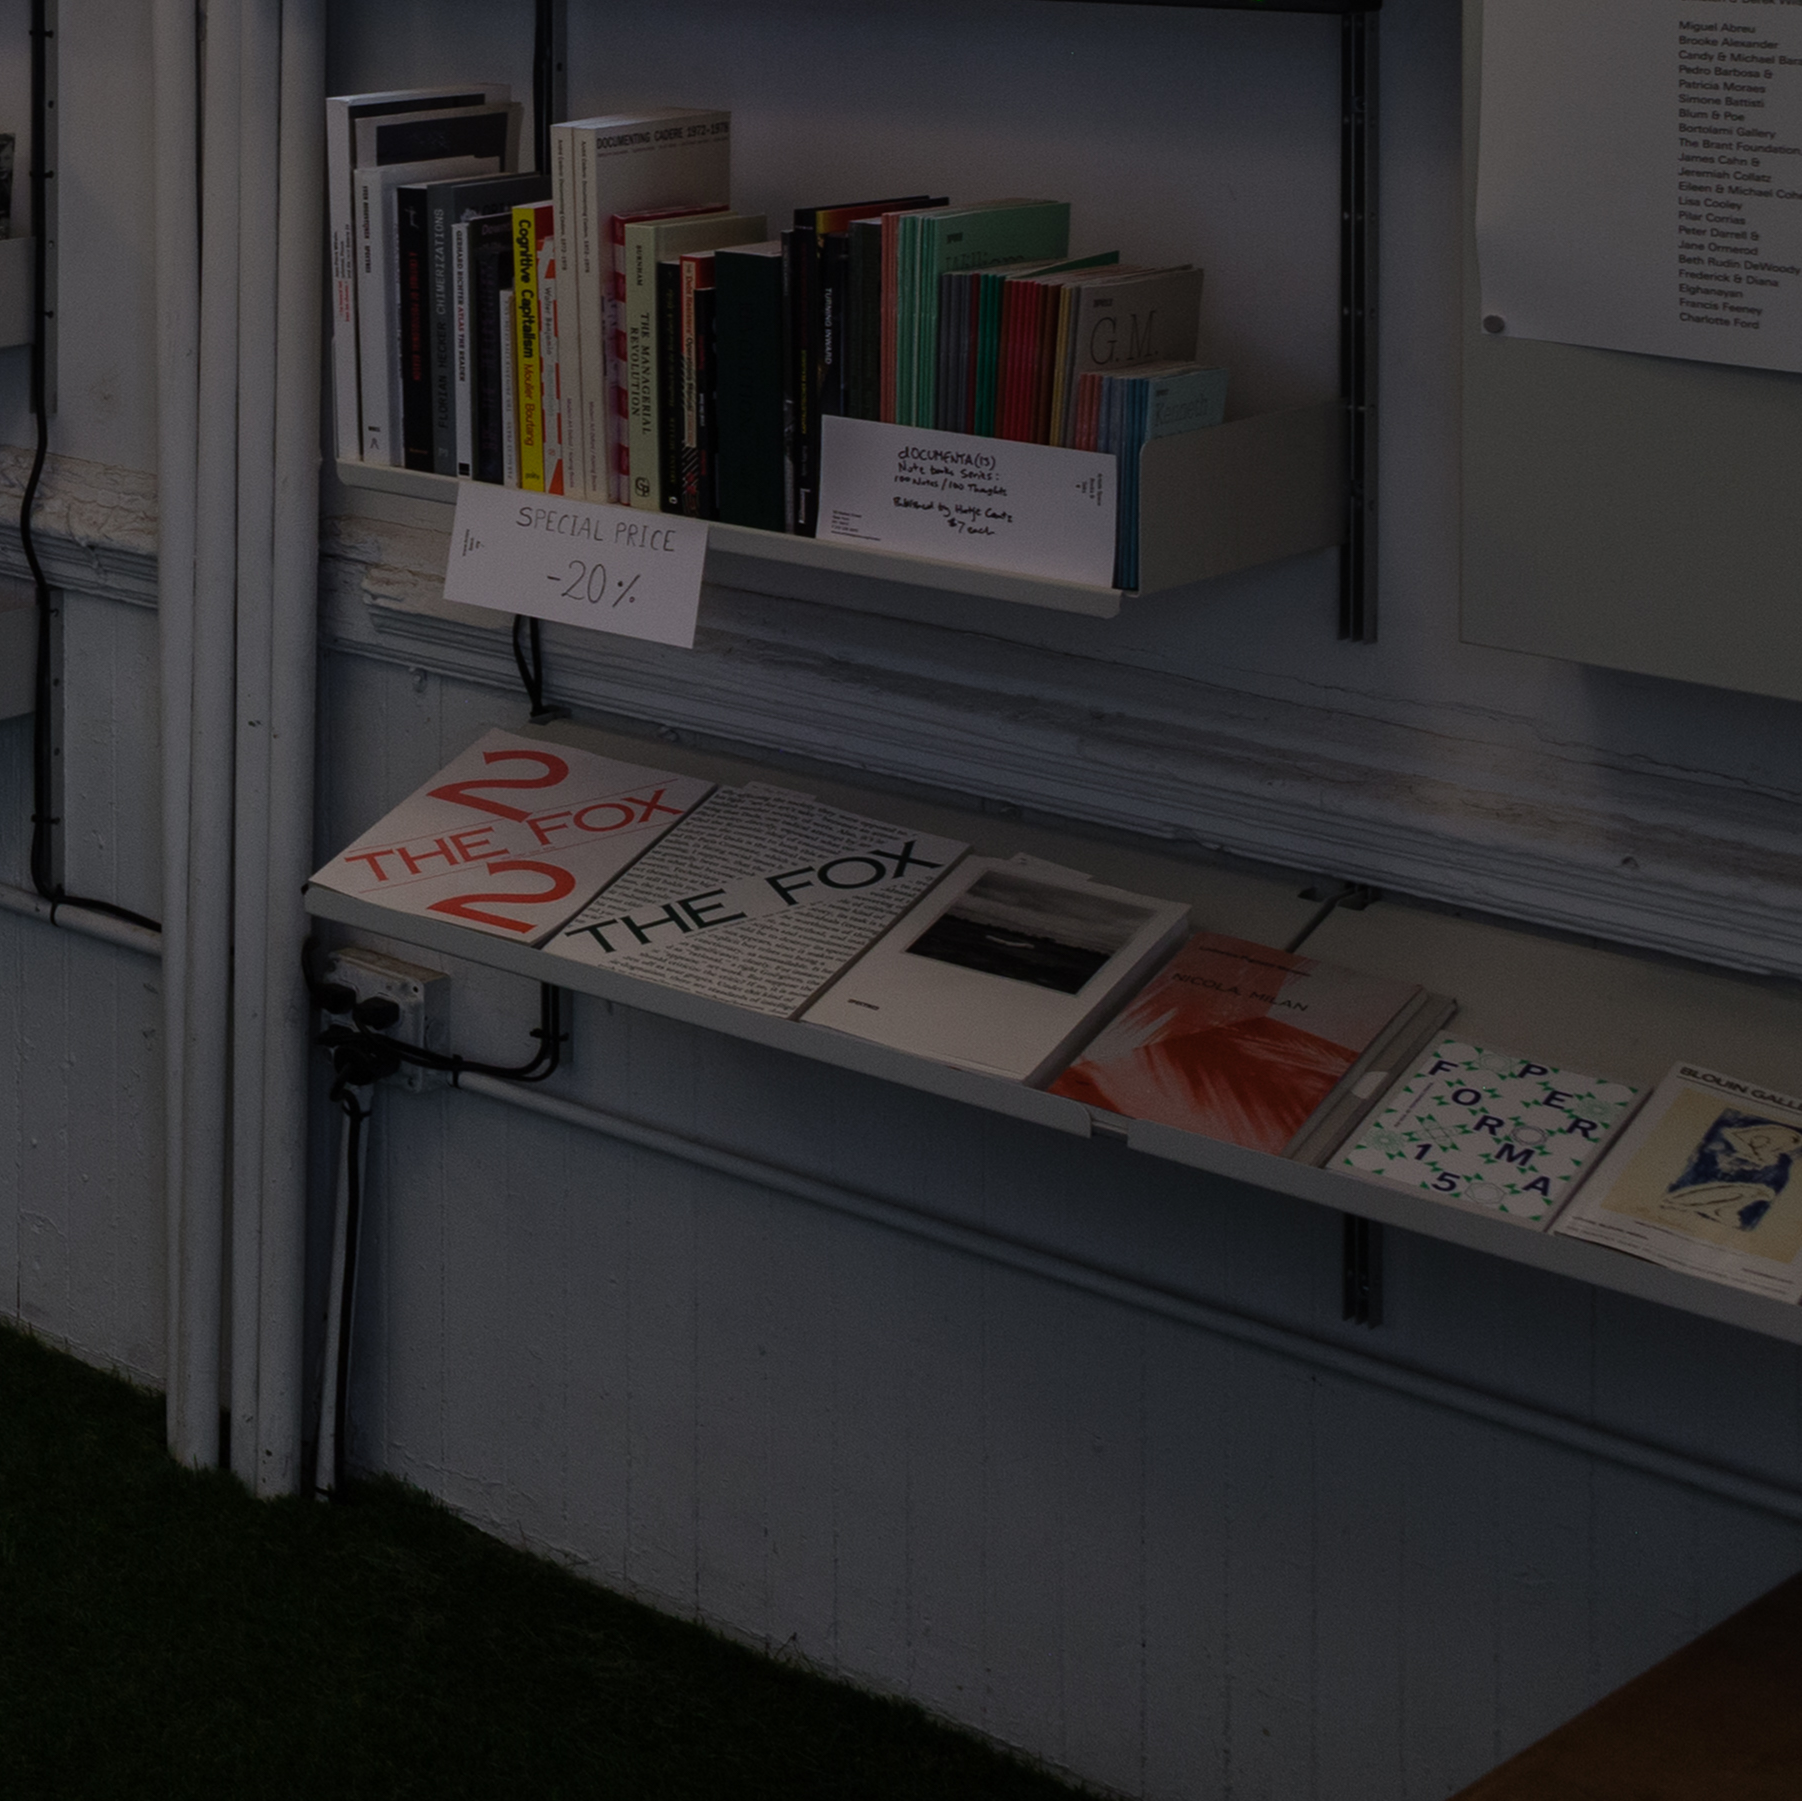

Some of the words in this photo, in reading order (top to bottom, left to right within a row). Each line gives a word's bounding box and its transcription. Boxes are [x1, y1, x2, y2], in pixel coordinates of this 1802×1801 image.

[596, 133, 650, 149] DOCUMENTING
[654, 127, 683, 142] CADERE
[434, 208, 445, 315] CHIMERIZATIONS
[517, 218, 531, 284] Cognitive
[437, 321, 447, 370] HECKER
[517, 288, 533, 358] Capitalism
[641, 313, 650, 336] THE
[438, 372, 448, 430] FLORIAN
[523, 363, 533, 401] Moulier
[630, 326, 641, 417] REVOLUTION
[641, 342, 651, 436] MANAGERIAL
[524, 404, 534, 447] Boutang
[516, 506, 604, 542] SPECIAL
[615, 521, 677, 552] PRICE
[428, 749, 570, 822] 2
[346, 827, 509, 882] THE
[526, 789, 684, 847] FOX
[428, 860, 576, 933] 2
[564, 888, 747, 954] THE
[765, 839, 945, 906] FOX
[1248, 990, 1309, 1012] MILAN
[1680, 1066, 1749, 1093] BLOUIN
